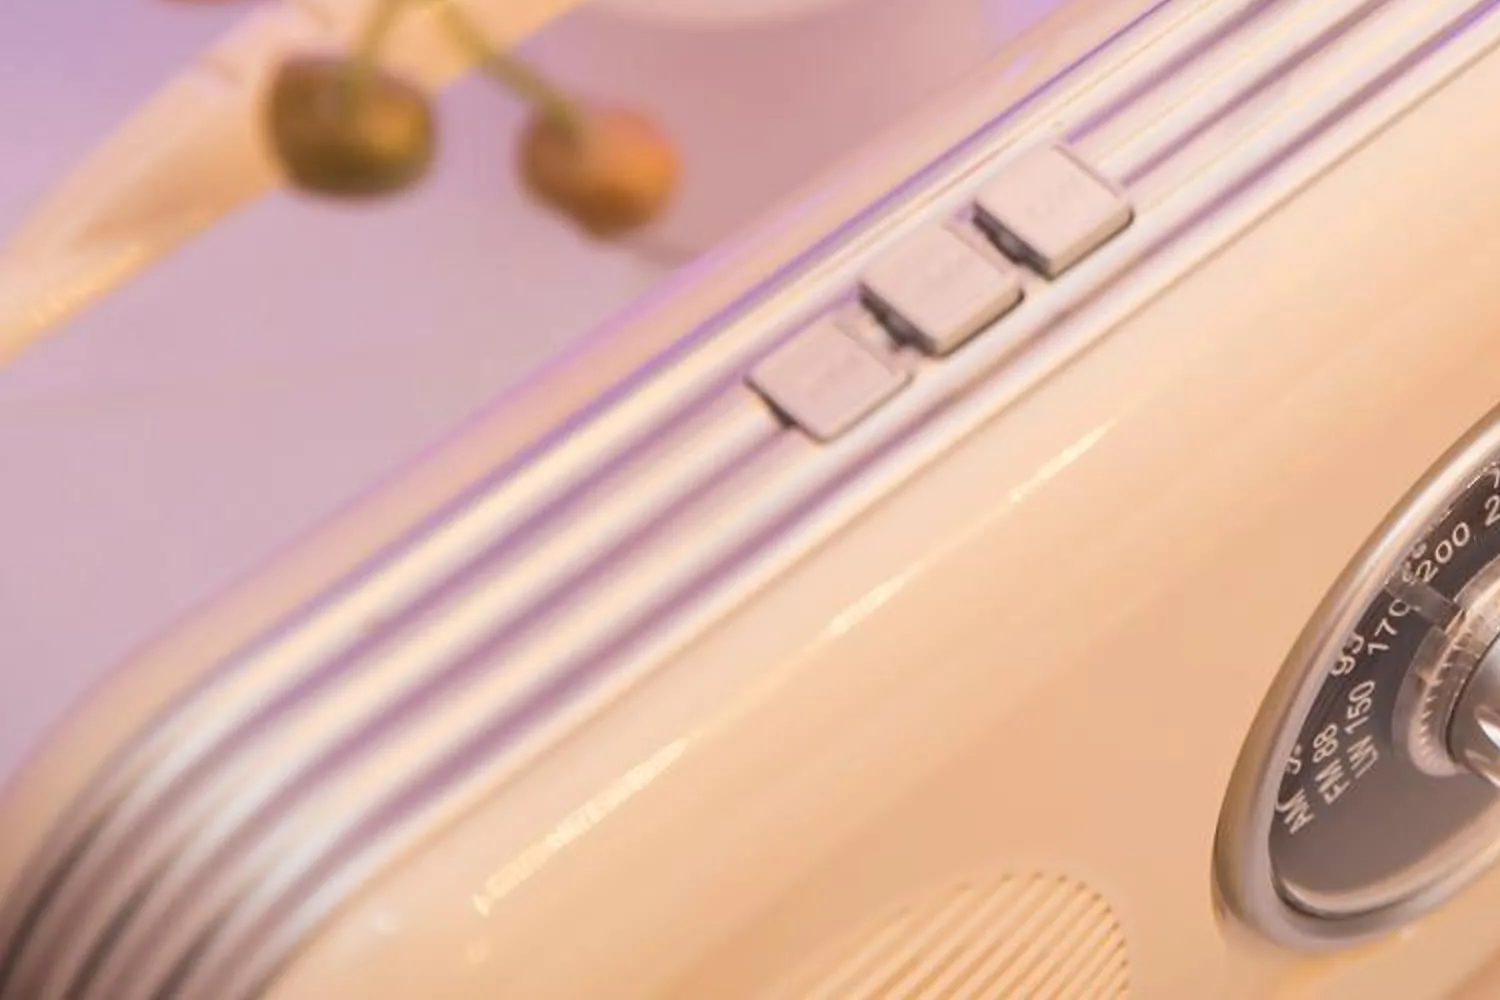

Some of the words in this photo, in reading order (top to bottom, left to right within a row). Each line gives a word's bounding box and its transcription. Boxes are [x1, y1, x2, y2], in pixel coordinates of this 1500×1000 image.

[1417, 522, 1471, 583] 200
[1366, 599, 1422, 655] 170
[1344, 680, 1376, 735] 150
[1312, 724, 1338, 763] 88
[1314, 758, 1351, 806] FM
